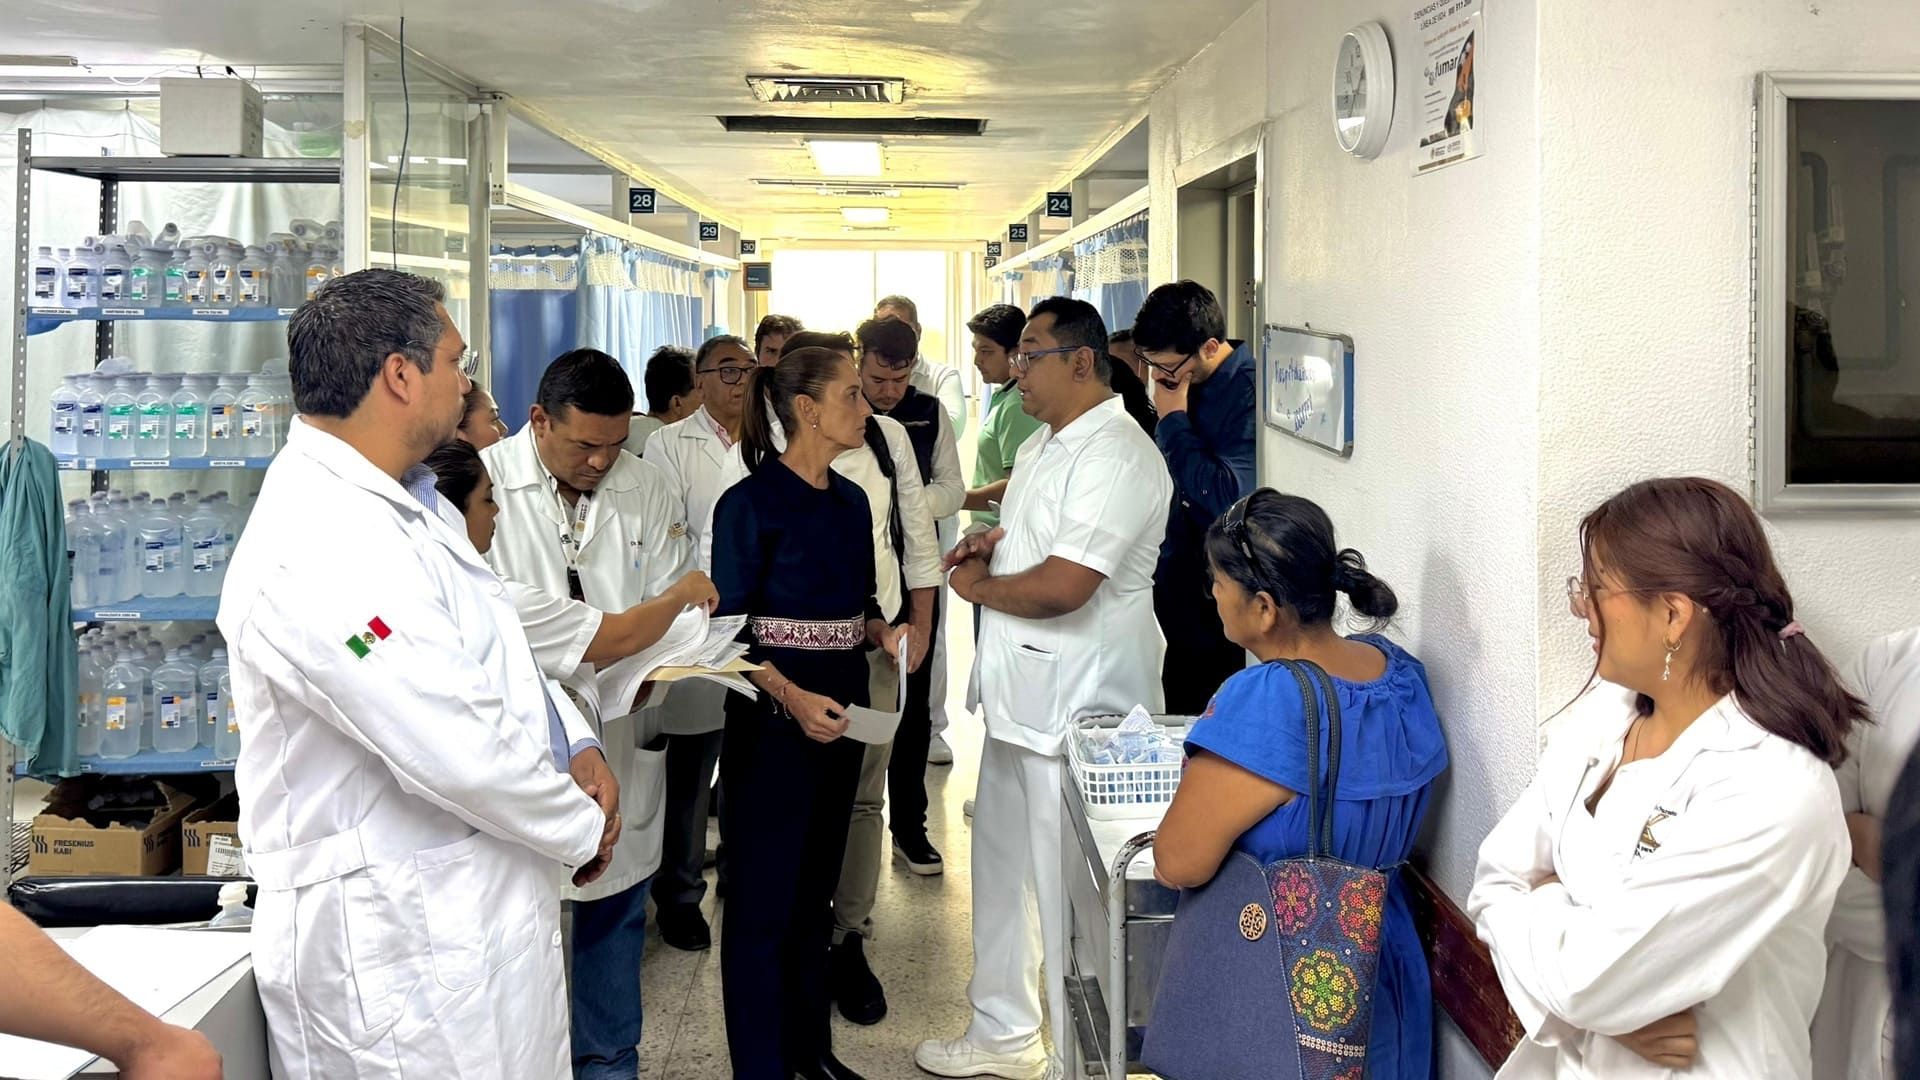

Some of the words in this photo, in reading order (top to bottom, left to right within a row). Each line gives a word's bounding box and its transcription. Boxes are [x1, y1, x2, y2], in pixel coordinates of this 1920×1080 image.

[633, 194, 651, 207] 28
[1050, 198, 1069, 211] 24
[702, 226, 717, 237] 29
[1011, 228, 1026, 238] 25
[743, 243, 755, 251] 30
[988, 245, 1000, 253] 26
[53, 839, 95, 848] FRESENIUS
[53, 847, 72, 855] KABI
